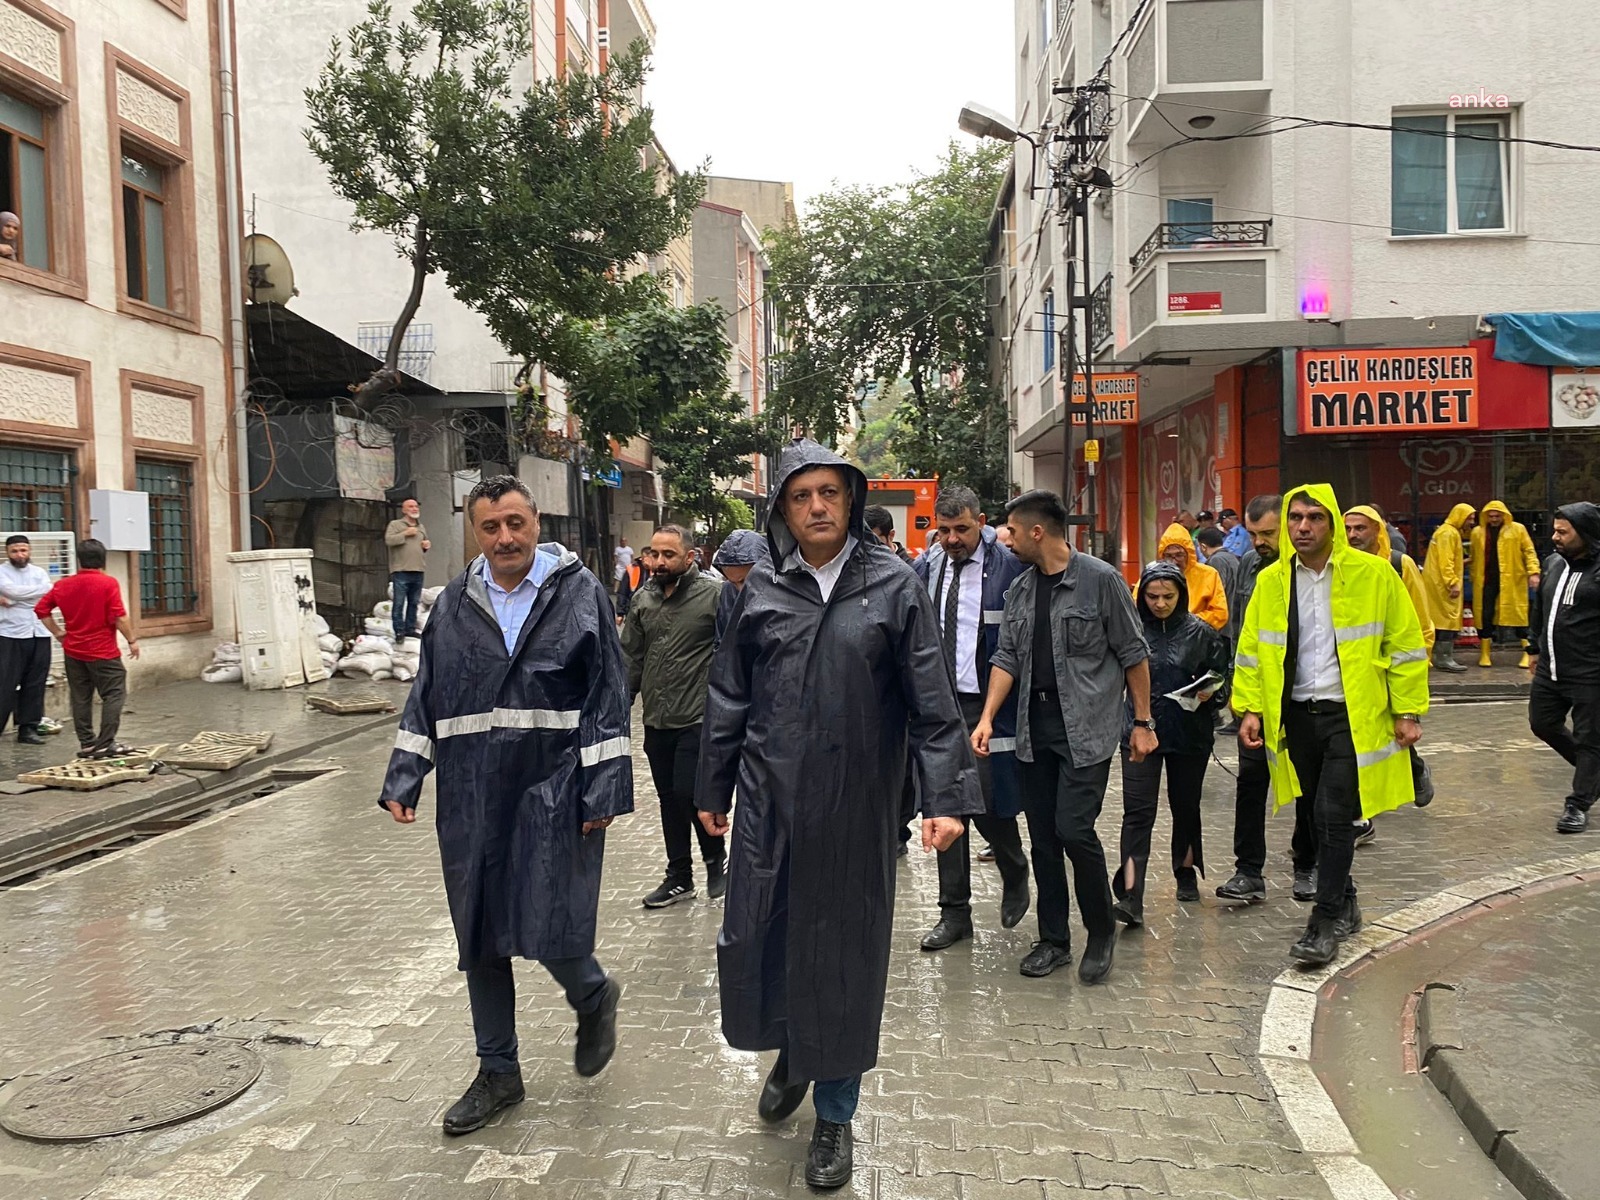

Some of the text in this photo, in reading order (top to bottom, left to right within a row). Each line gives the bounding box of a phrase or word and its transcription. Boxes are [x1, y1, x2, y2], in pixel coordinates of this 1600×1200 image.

[1306, 355, 1474, 387] ÇELİK KARDEŞLER
[1311, 389, 1473, 427] MARKET
